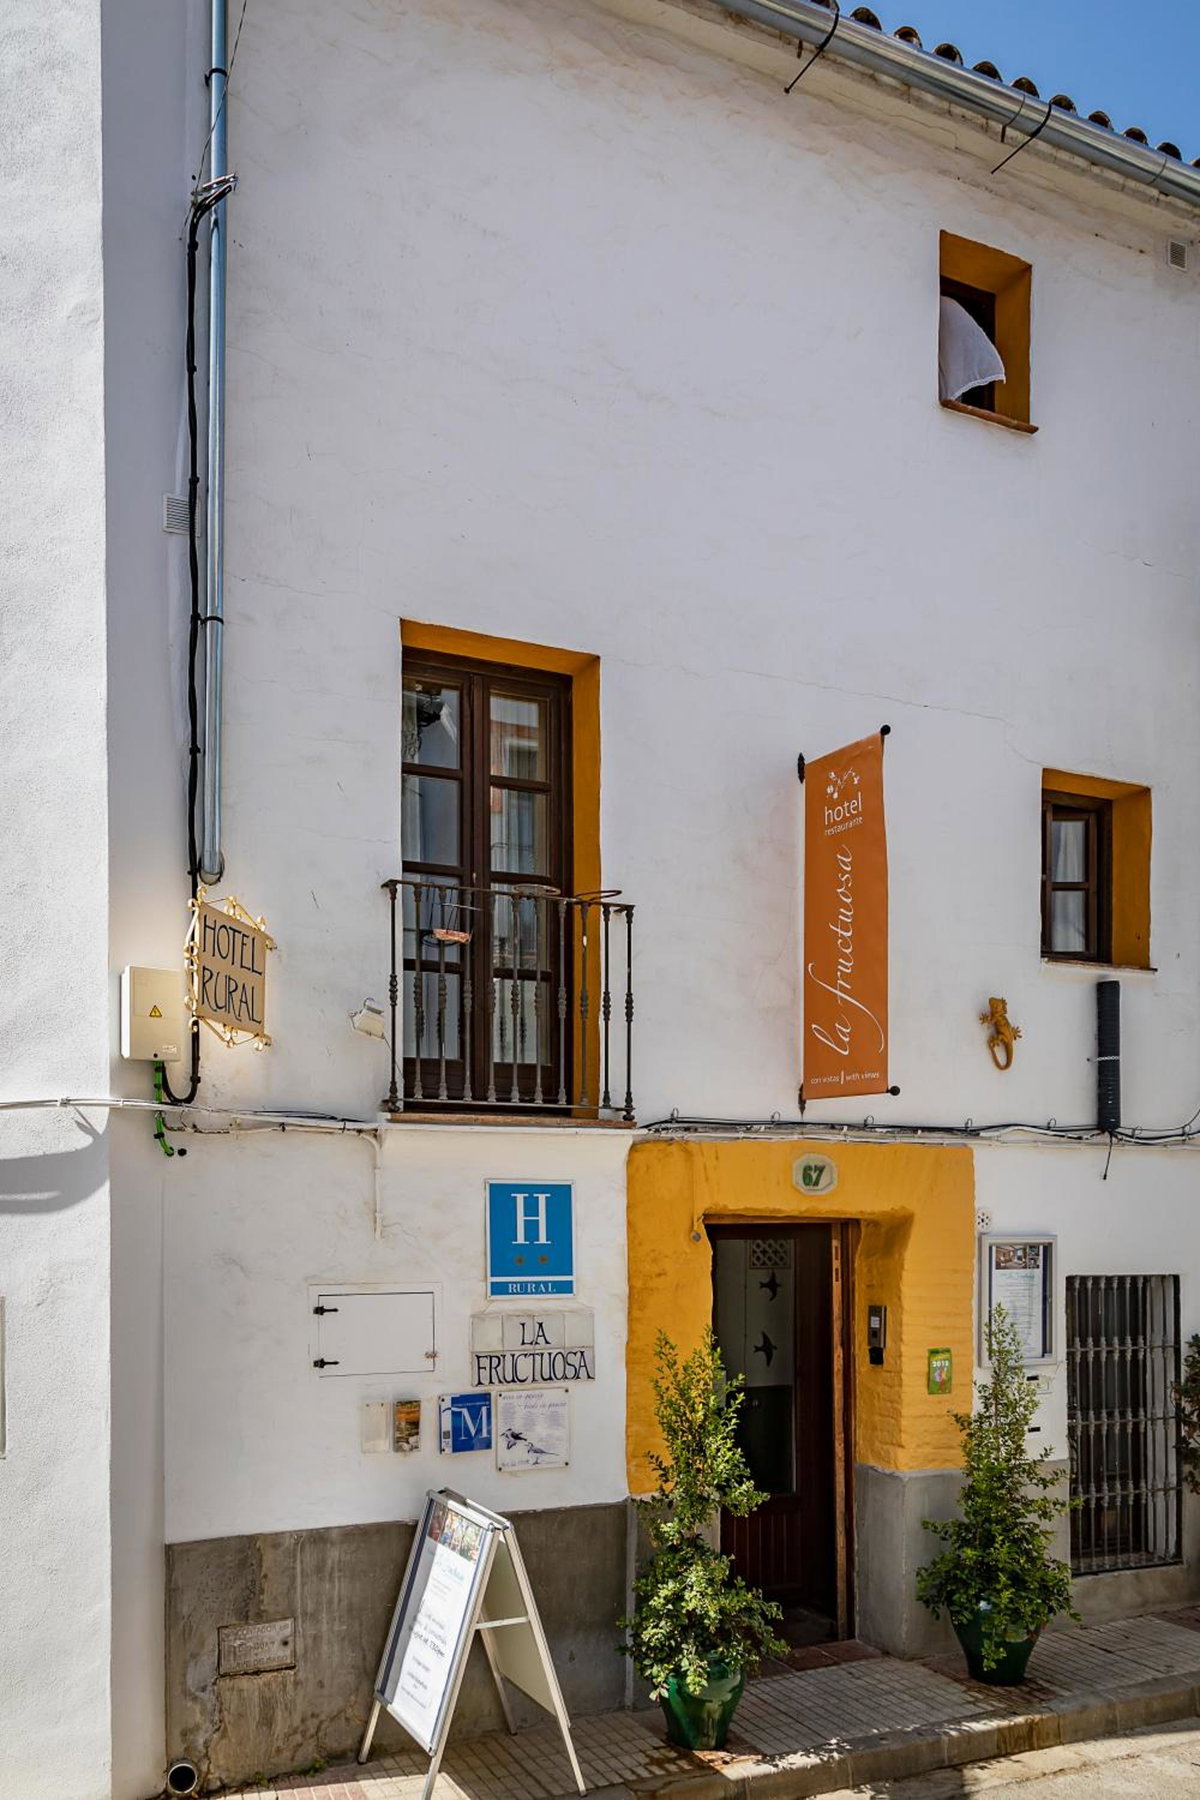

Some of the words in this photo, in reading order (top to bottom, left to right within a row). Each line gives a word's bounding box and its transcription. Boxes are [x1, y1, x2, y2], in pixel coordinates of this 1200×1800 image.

[824, 792, 862, 825] hotel
[824, 816, 864, 836] restaurante
[202, 914, 262, 976] HOTEL
[808, 844, 885, 1054] fructuosa
[201, 965, 262, 1025] RURAL
[811, 1014, 852, 1056] la
[802, 1165, 826, 1187] 67
[511, 1193, 552, 1244] H
[508, 1282, 557, 1294] RURAL
[520, 1321, 551, 1346] LA
[474, 1350, 595, 1387] FRUCTUOSA
[453, 1405, 490, 1440] M
